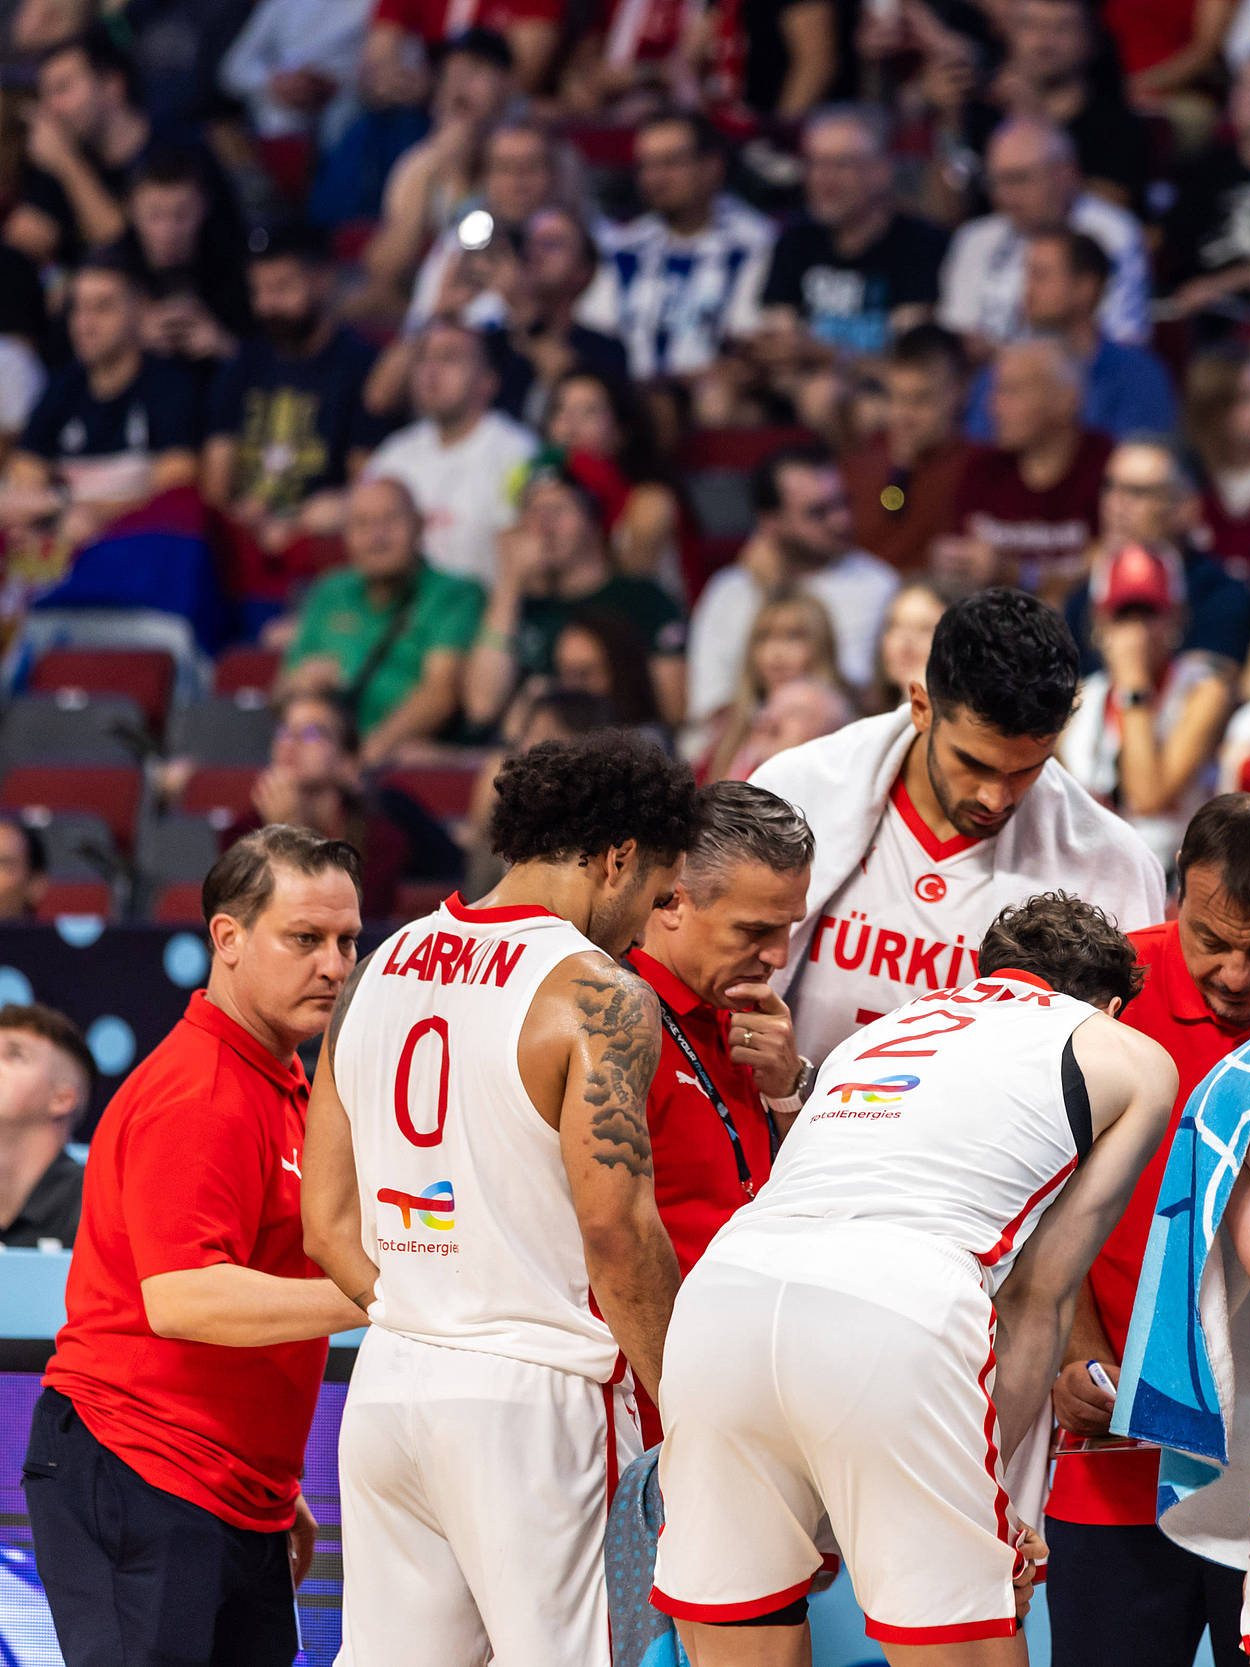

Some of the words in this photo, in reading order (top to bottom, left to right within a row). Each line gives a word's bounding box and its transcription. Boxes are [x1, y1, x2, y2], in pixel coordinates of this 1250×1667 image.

[382, 931, 528, 988] LARKIN
[853, 1009, 977, 1062] 2
[394, 1015, 450, 1148] 0
